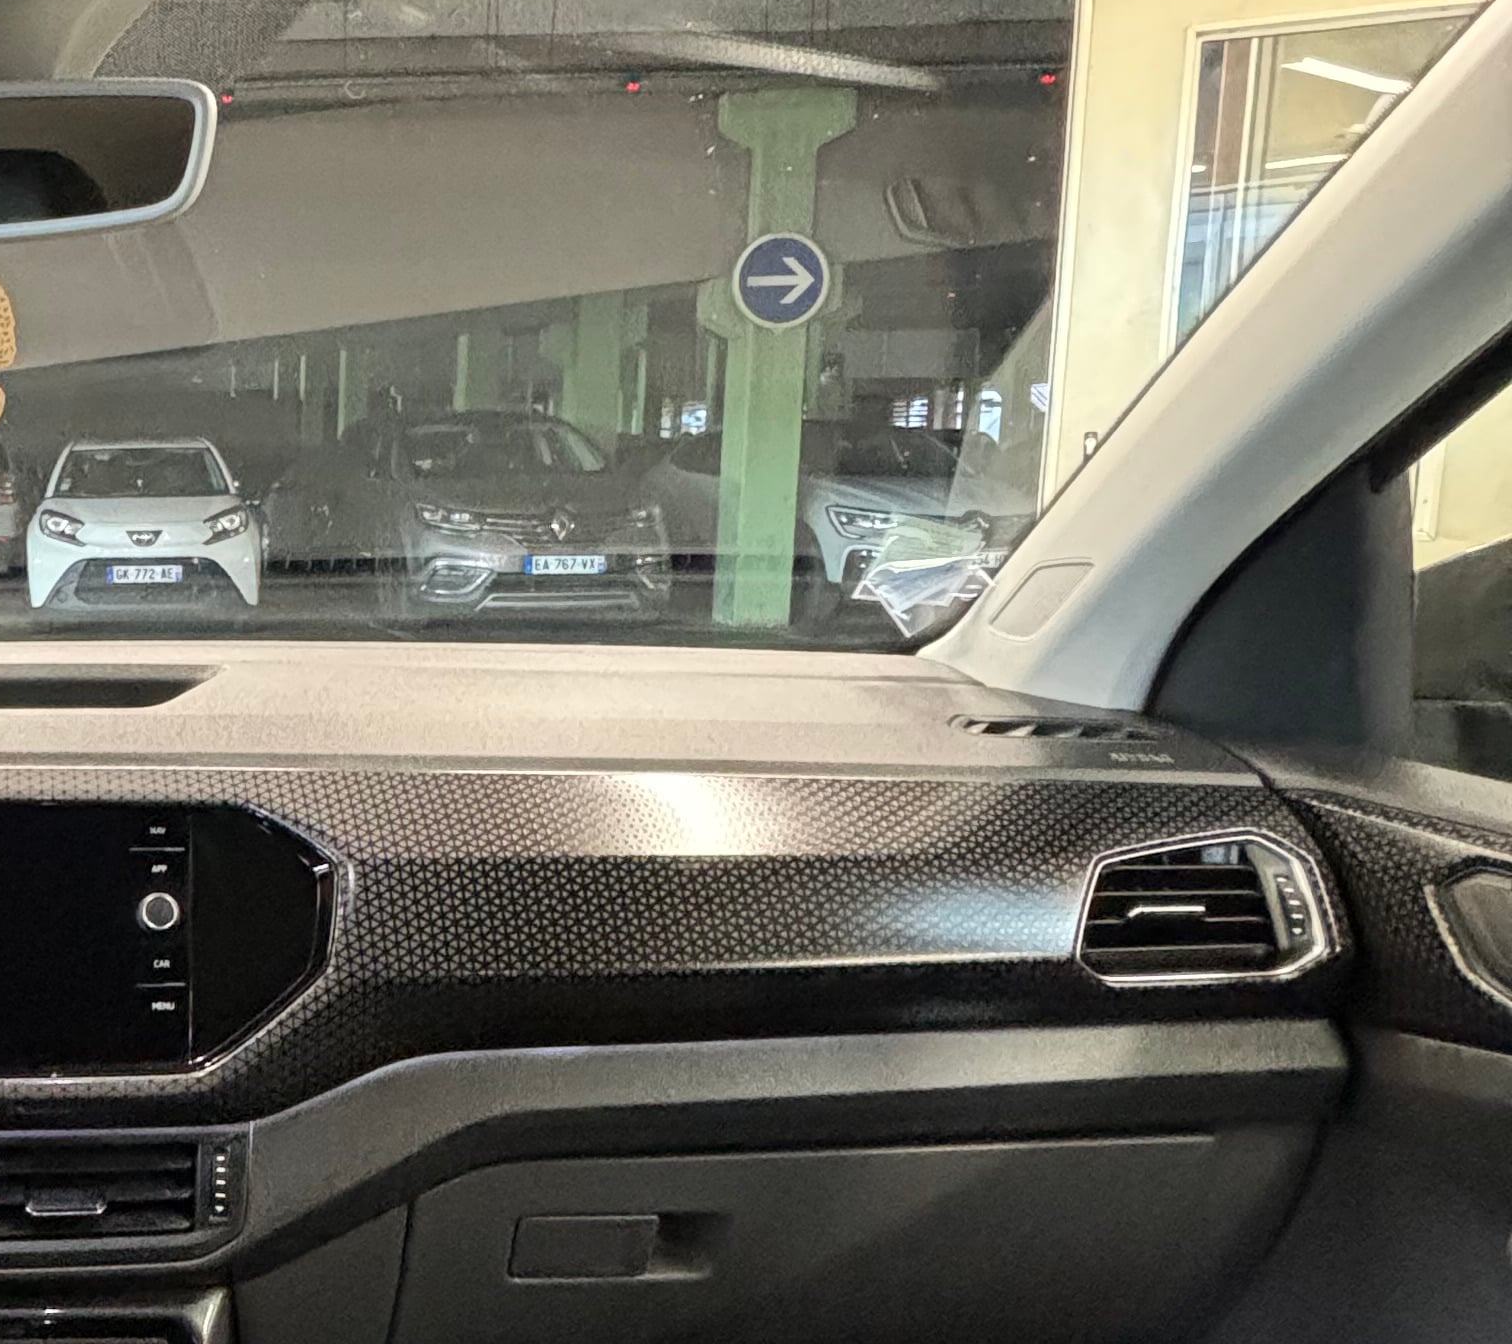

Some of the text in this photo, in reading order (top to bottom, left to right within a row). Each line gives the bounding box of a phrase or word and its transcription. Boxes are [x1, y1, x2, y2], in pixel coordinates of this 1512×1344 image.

[151, 864, 168, 873] APP
[153, 959, 171, 968] CAR
[151, 1001, 176, 1011] MENU
